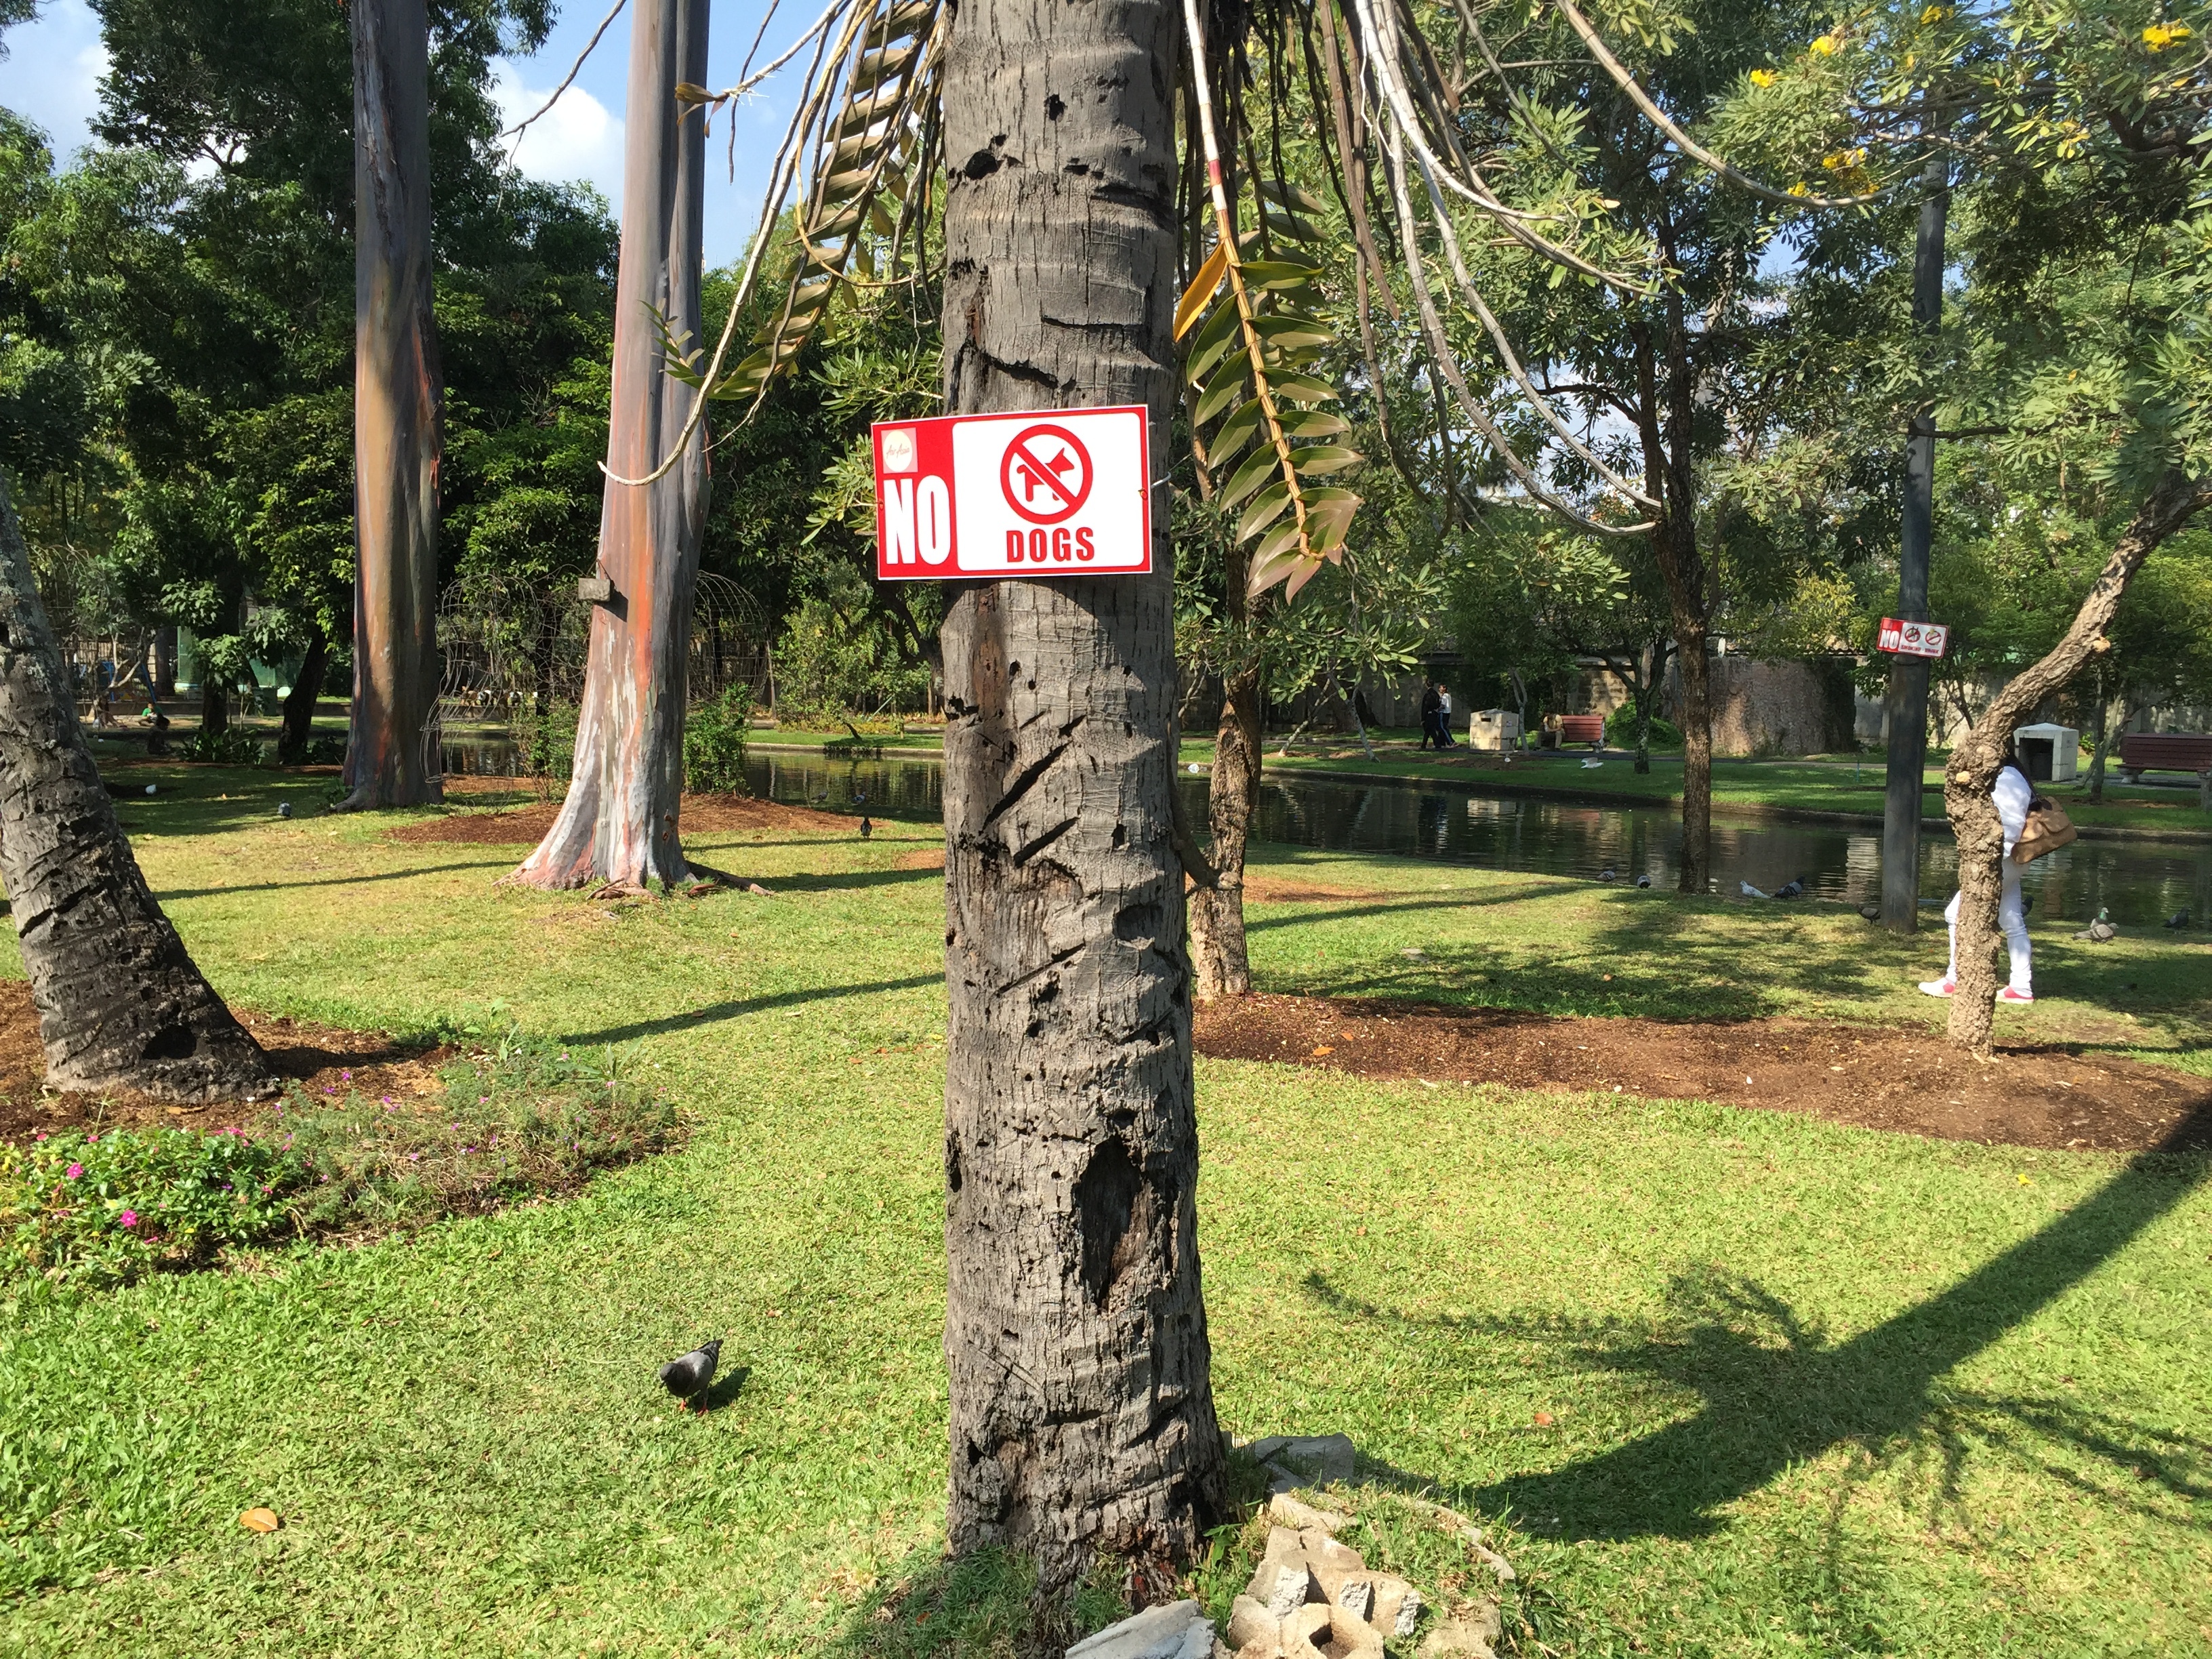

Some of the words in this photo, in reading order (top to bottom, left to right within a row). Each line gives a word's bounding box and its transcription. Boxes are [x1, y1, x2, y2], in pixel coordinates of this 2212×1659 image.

[884, 475, 950, 565] NO
[1006, 527, 1094, 562] DOGS
[1879, 630, 1900, 649] NO
